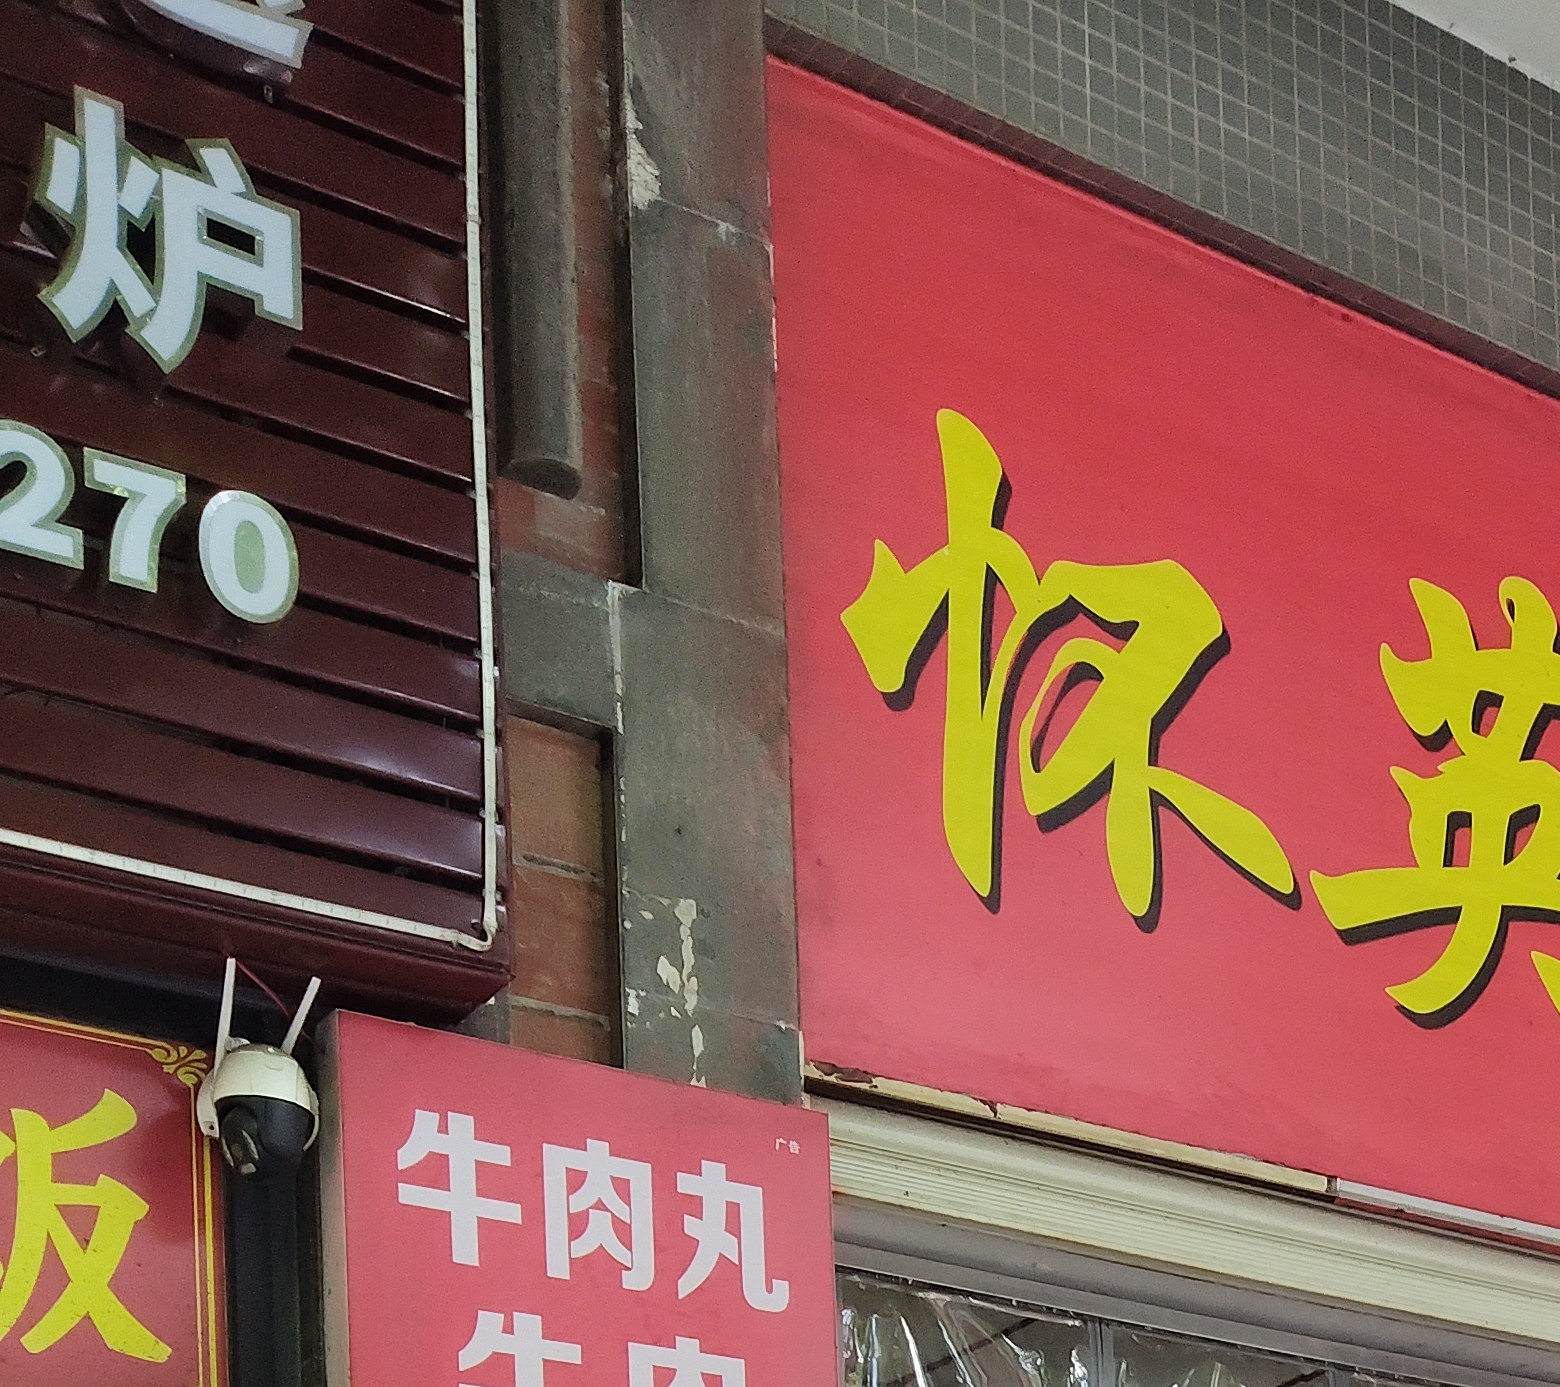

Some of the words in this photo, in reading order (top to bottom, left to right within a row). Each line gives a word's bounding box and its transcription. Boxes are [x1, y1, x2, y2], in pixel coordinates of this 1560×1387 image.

[38, 86, 303, 373] 炉
[397, 1108, 790, 1312] 牛肉丸
